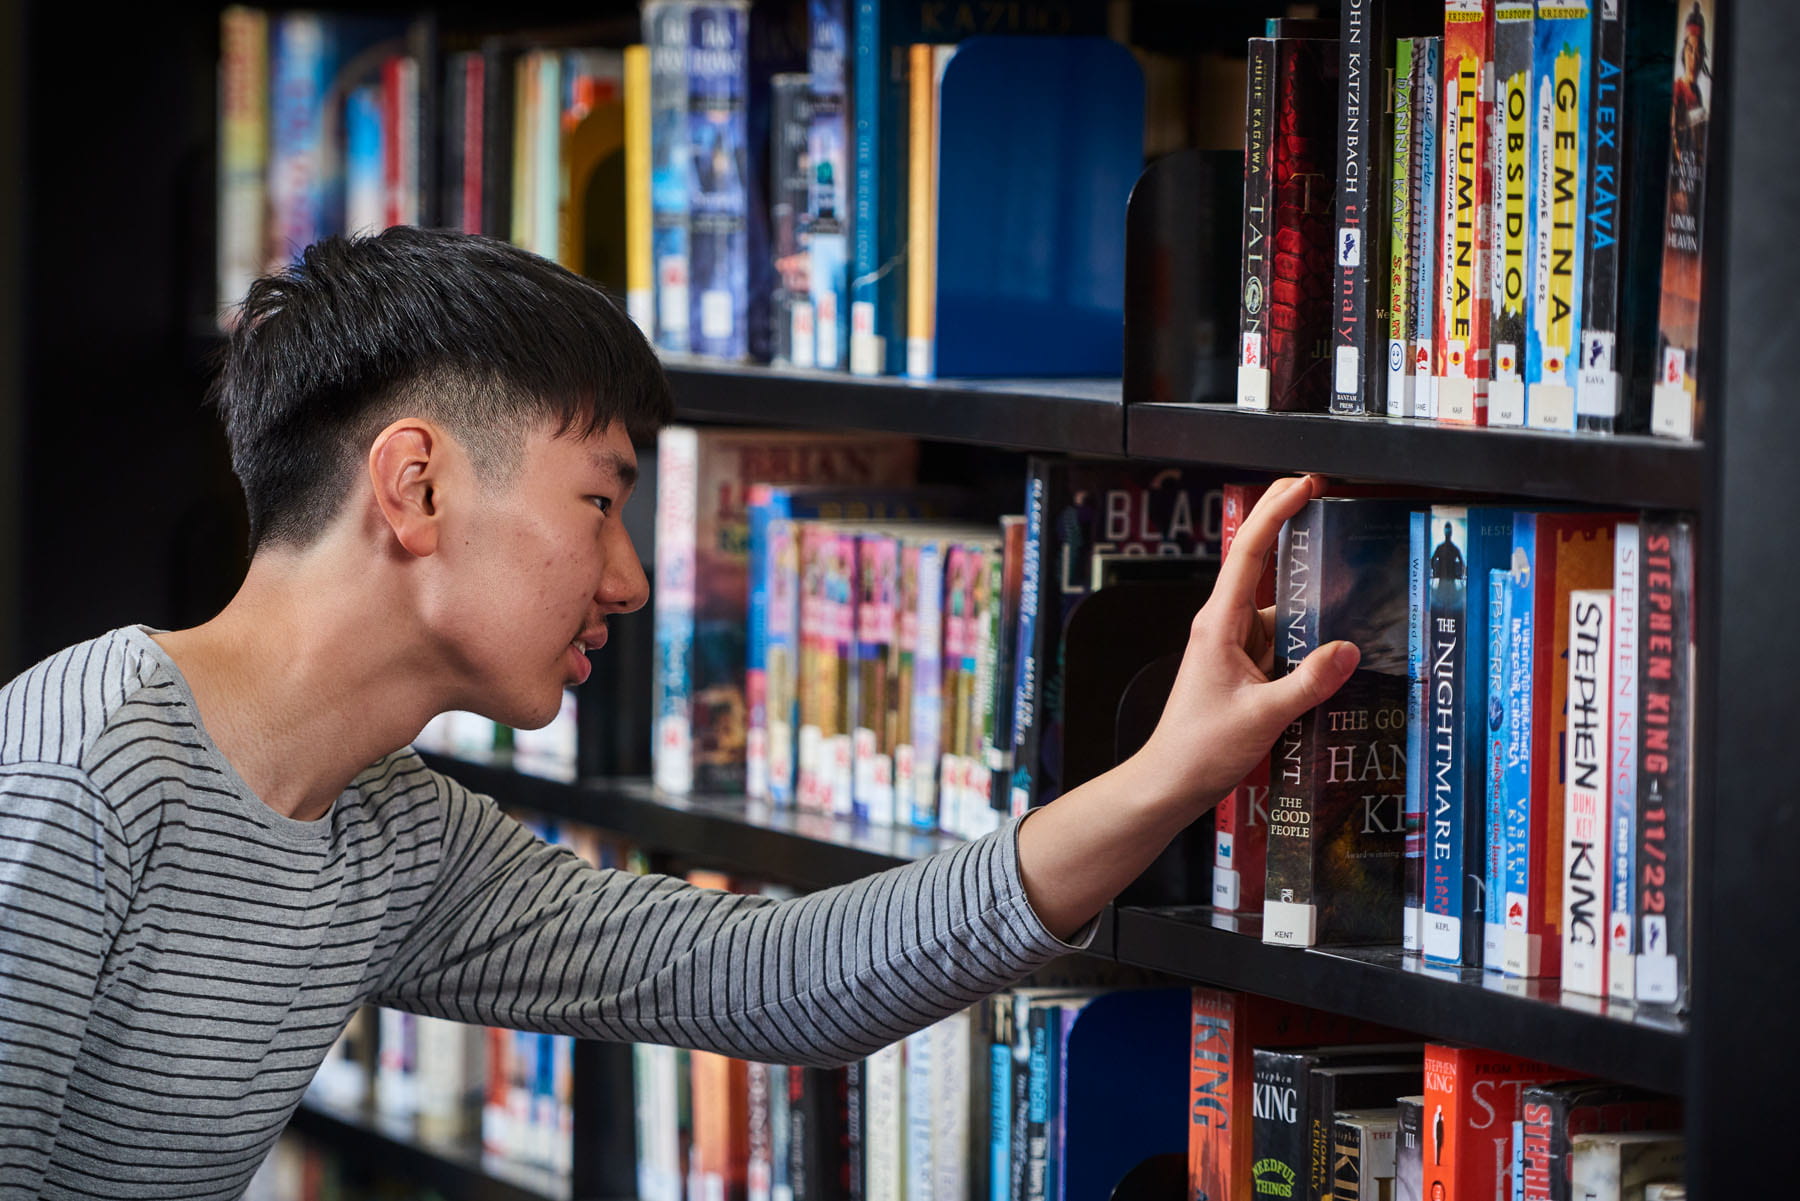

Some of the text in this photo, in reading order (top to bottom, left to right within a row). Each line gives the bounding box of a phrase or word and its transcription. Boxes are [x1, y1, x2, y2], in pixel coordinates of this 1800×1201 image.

[1448, 12, 1482, 22] KRISTOFF
[1541, 8, 1586, 18] KRISTOFF
[1252, 55, 1262, 173] JULIE KAGAWA
[1346, 0, 1361, 193] OHN KATZENBACH
[1449, 108, 1457, 135] THE
[1542, 105, 1550, 131] THE
[1392, 77, 1409, 240] DANNY KATZ
[1587, 58, 1622, 250] ALEX KAVA
[1446, 148, 1455, 220] ILLUMINAE
[1456, 71, 1475, 336] ILLUMINAE
[1505, 88, 1525, 300] OBSIDIO
[1552, 78, 1577, 325] GEMINA
[1345, 204, 1360, 229] th
[1668, 232, 1697, 251] HEAVEN
[1339, 265, 1358, 346] analy
[1585, 375, 1605, 385] KAVA
[1106, 489, 1224, 542] BLAC
[1480, 525, 1513, 537] BESTS
[1411, 557, 1420, 597] Water
[1409, 604, 1418, 639] Road
[1436, 617, 1457, 634] THE
[1647, 534, 1673, 680] STEPHEN
[1520, 628, 1530, 692] UNEXPECTED
[1617, 548, 1634, 796] STEPHEN KING
[1507, 618, 1522, 767] INSPECTOR CHOPRA
[1574, 601, 1603, 790] STEPHEN
[1328, 708, 1406, 732] THE GO
[1645, 692, 1670, 774] KING
[1283, 720, 1303, 785] ENT
[1326, 740, 1407, 784] HAN
[1433, 636, 1457, 861] NIGHTMARE
[1271, 809, 1310, 824] GOOD
[1278, 796, 1303, 809] THE
[1573, 791, 1597, 816] DUMA
[1270, 824, 1310, 838] PEOPLE
[1506, 809, 1517, 871] KHAN
[1515, 797, 1527, 885] VASEEM
[1575, 818, 1592, 840] KEY
[1617, 816, 1629, 855] END
[1616, 857, 1628, 880] OF
[1643, 807, 1666, 913] 11/22
[1570, 839, 1597, 949] KING
[1274, 930, 1293, 940] KENT
[1435, 921, 1450, 932] KEPL
[1193, 1013, 1230, 1131] KING
[1256, 1071, 1292, 1084] stephen
[1424, 1058, 1457, 1075] STEPHEN
[1426, 1071, 1453, 1094] KING
[1475, 1063, 1544, 1075] FROM THE
[1252, 1082, 1297, 1124] KING
[1311, 1119, 1320, 1191] KENEALLY
[1320, 1127, 1328, 1185] THOMAS
[1371, 1131, 1393, 1141] THE
[1405, 1132, 1415, 1149] III
[1524, 1103, 1552, 1201] STEPHE
[1252, 1158, 1296, 1186] NEEDFUL
[1255, 1179, 1293, 1198] THINGS
